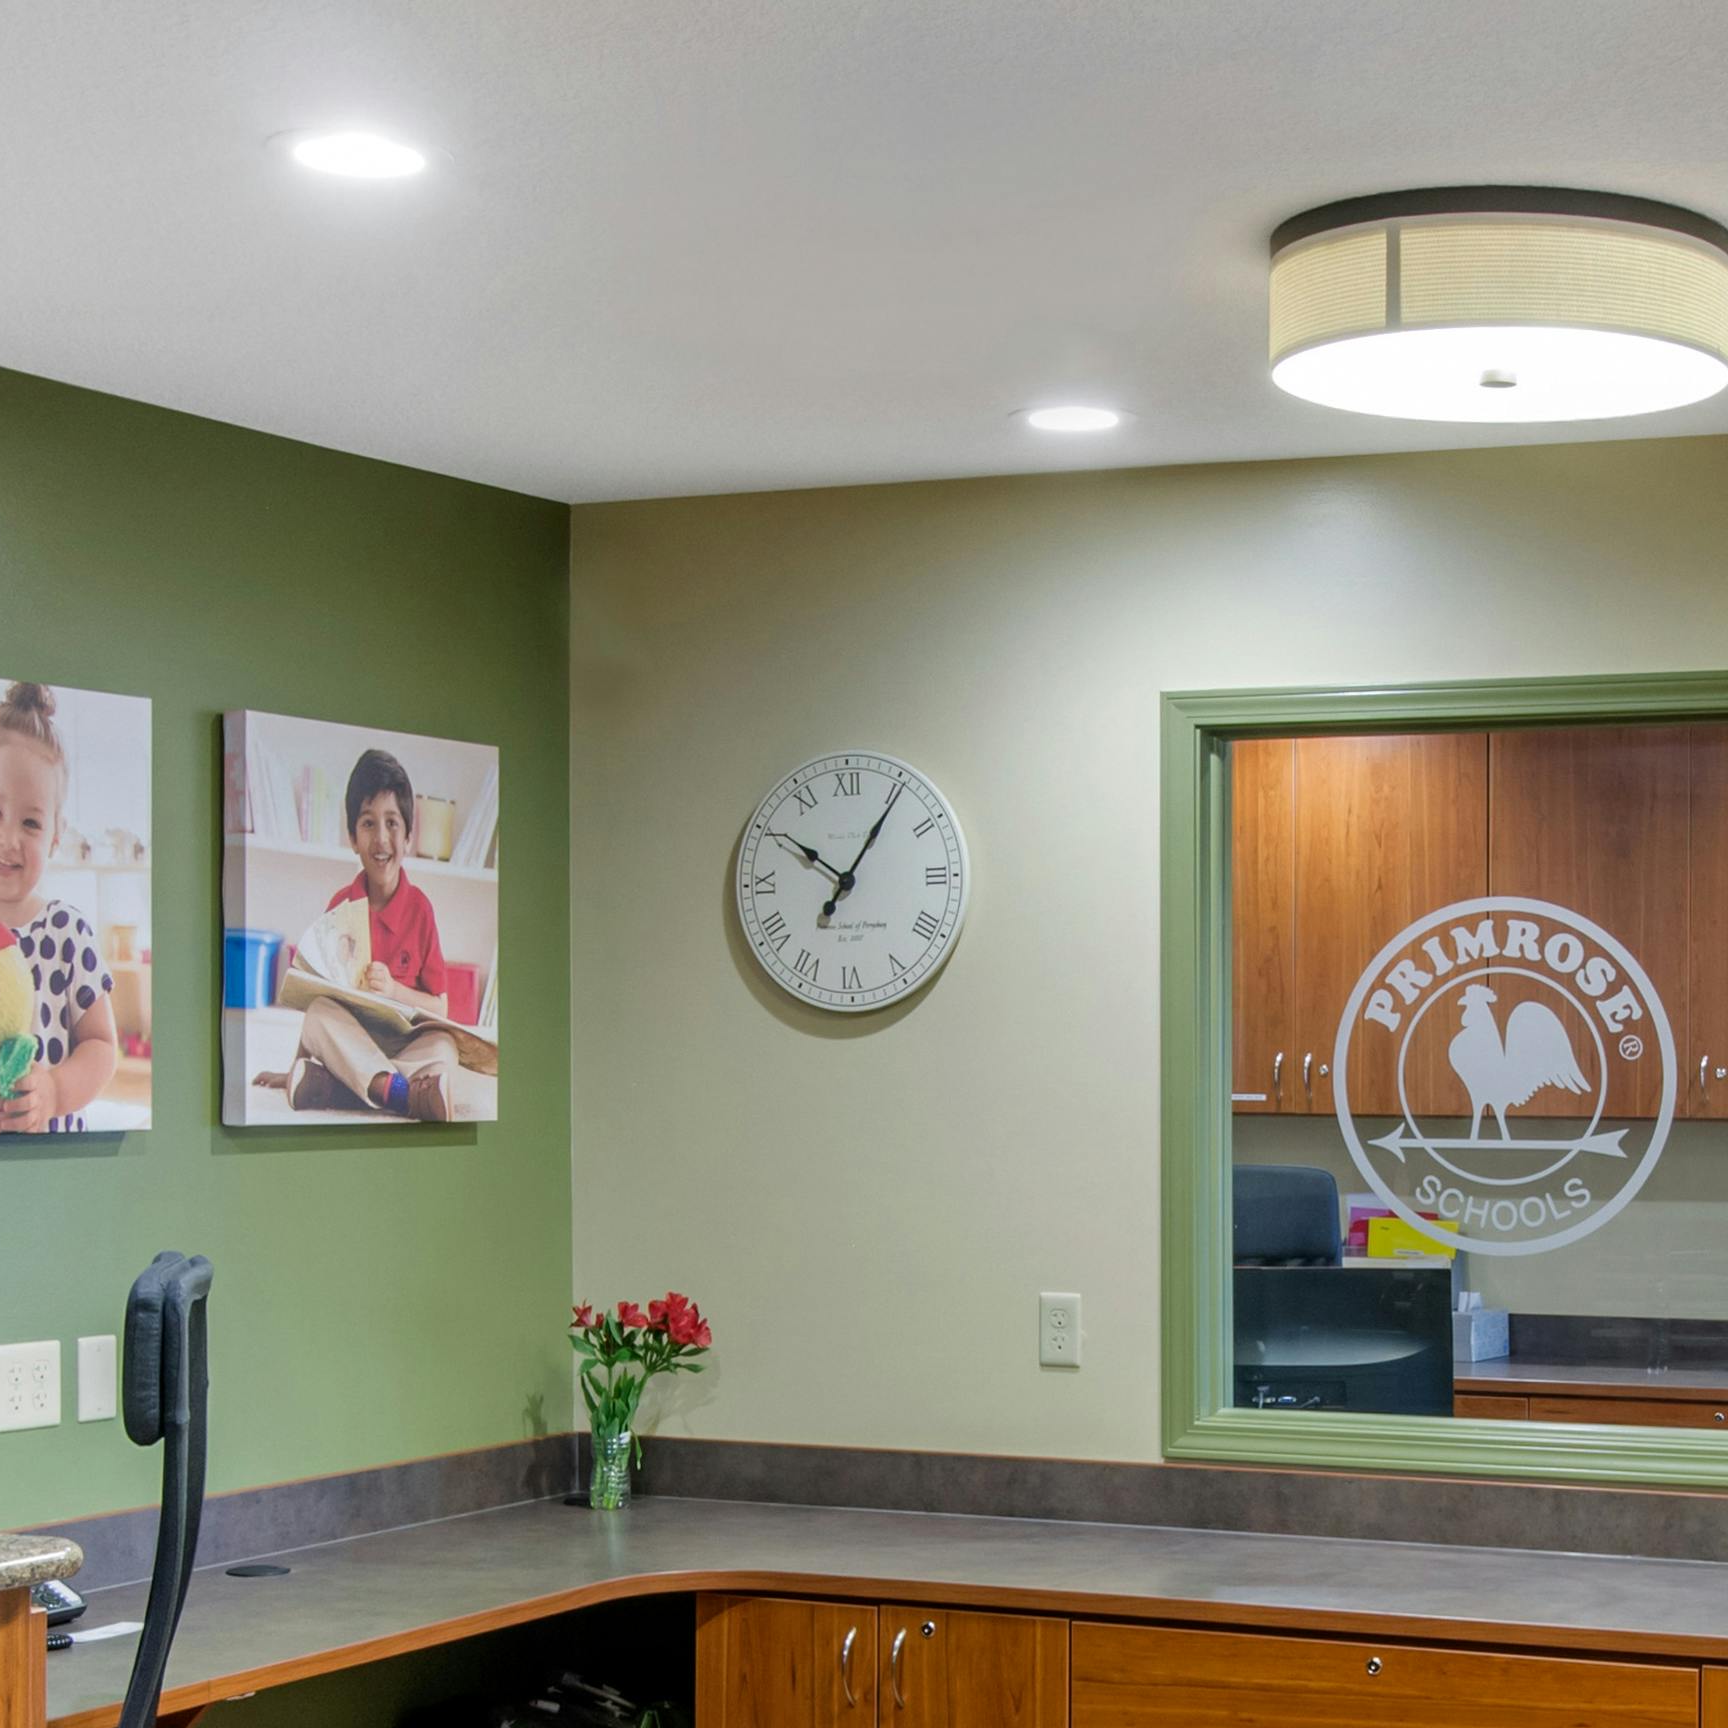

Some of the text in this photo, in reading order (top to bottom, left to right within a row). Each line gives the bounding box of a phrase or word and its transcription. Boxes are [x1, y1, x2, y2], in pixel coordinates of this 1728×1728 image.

[832, 771, 861, 797] XII
[793, 785, 818, 816] XI
[913, 816, 935, 838] II
[755, 870, 775, 895] IX
[926, 866, 947, 887] III
[762, 911, 791, 952] VIII
[793, 949, 820, 982] VII
[841, 965, 863, 989] VI
[888, 953, 906, 977] V
[1415, 1175, 1591, 1231] SCHOOLS
